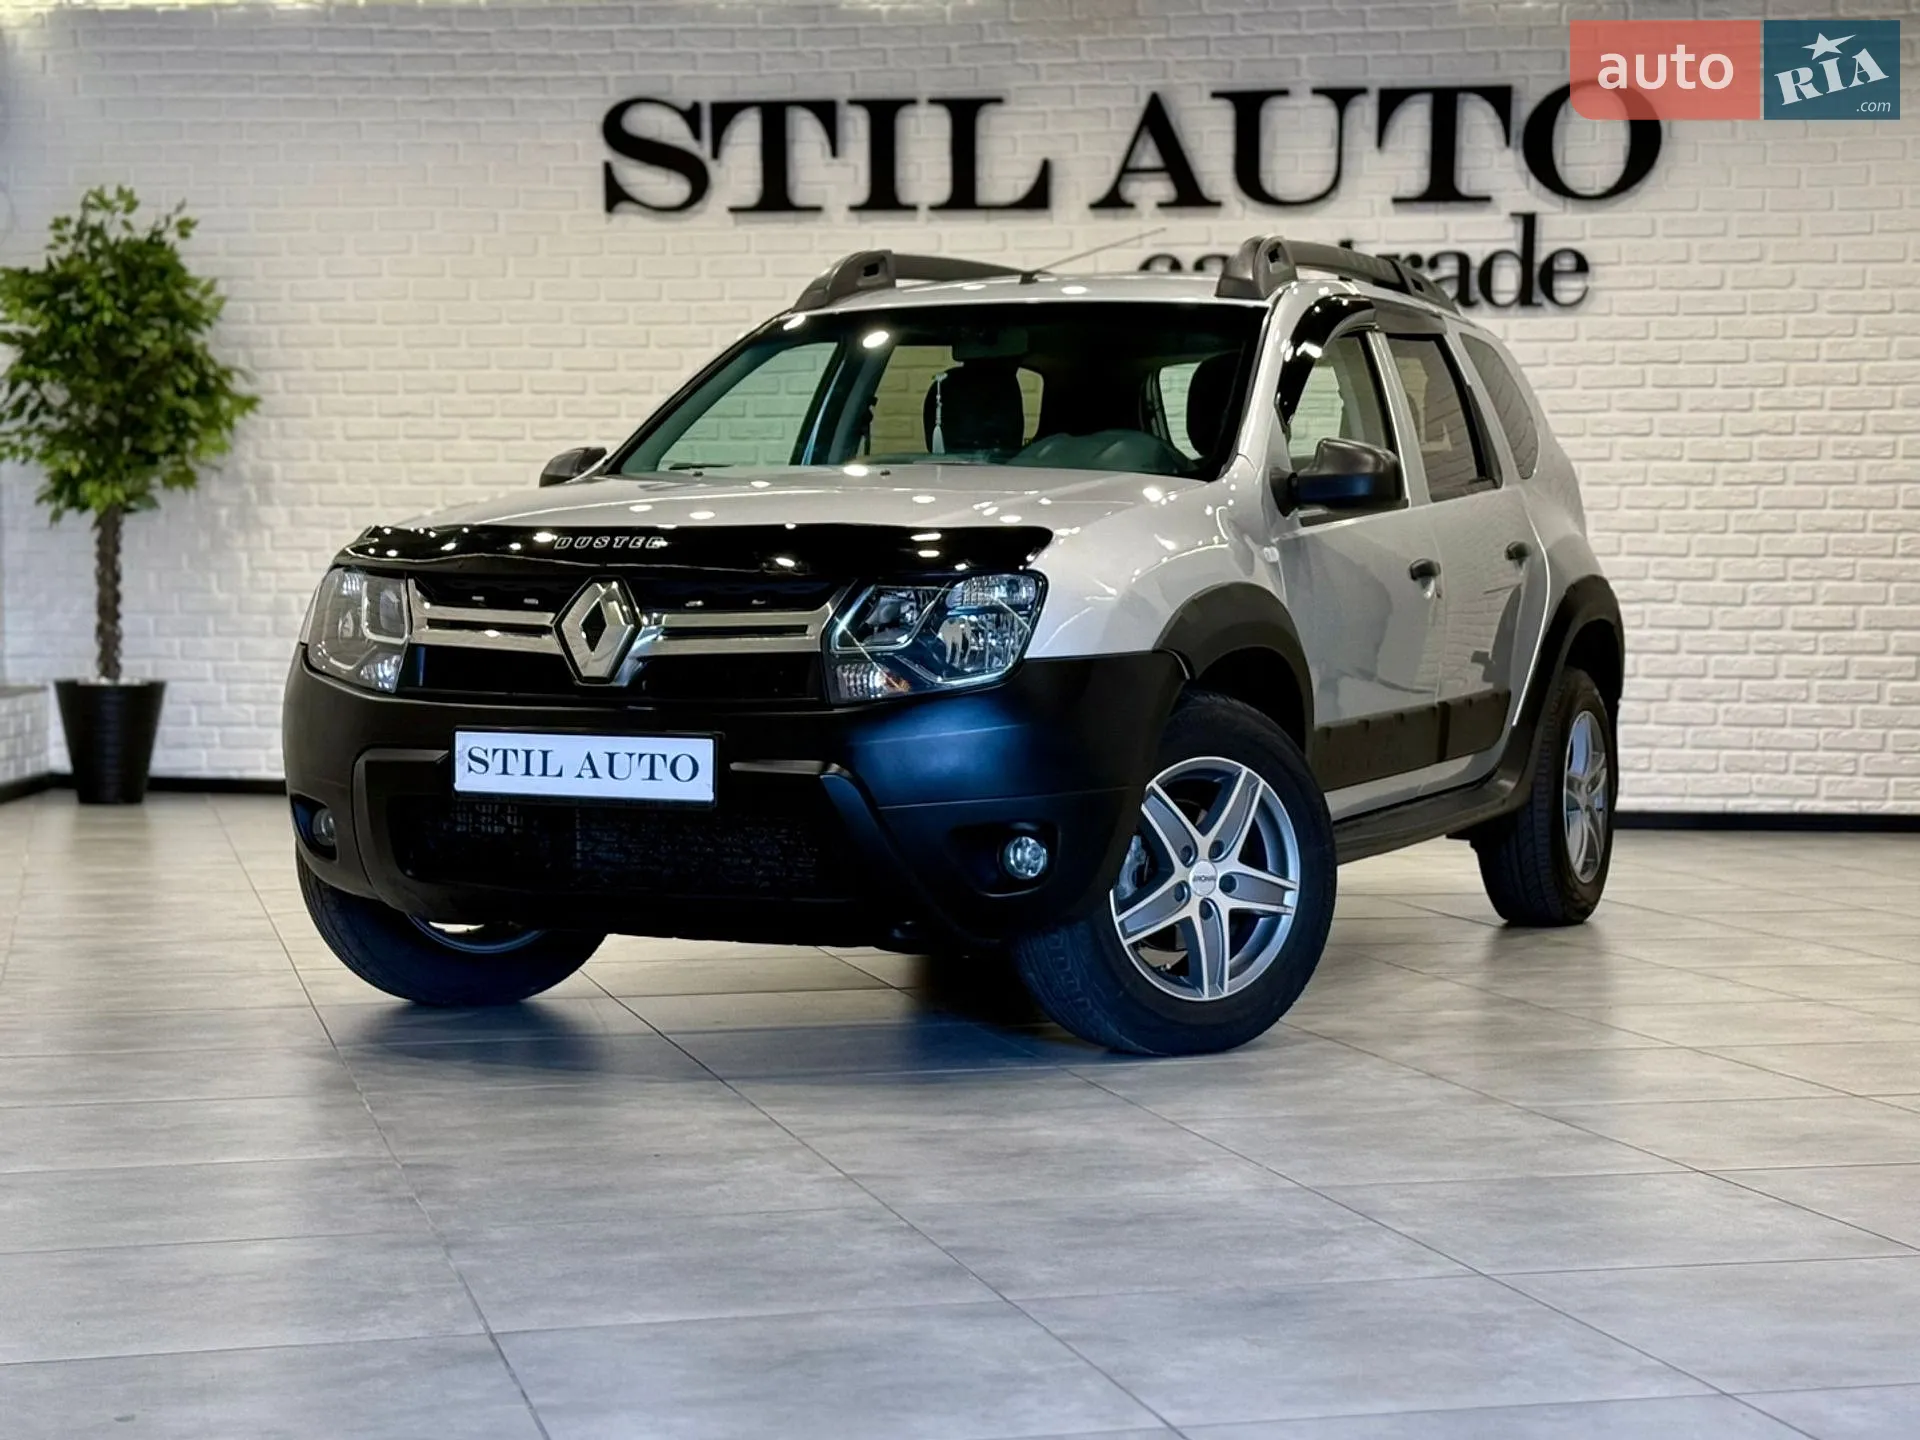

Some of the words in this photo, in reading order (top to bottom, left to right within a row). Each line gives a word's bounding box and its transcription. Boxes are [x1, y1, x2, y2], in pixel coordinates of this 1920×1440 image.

[602, 97, 1053, 213] STIL
[1089, 80, 1662, 209] AUTO
[1338, 212, 1590, 309] ade
[467, 746, 564, 778] STIL
[574, 751, 700, 783] AUTO
